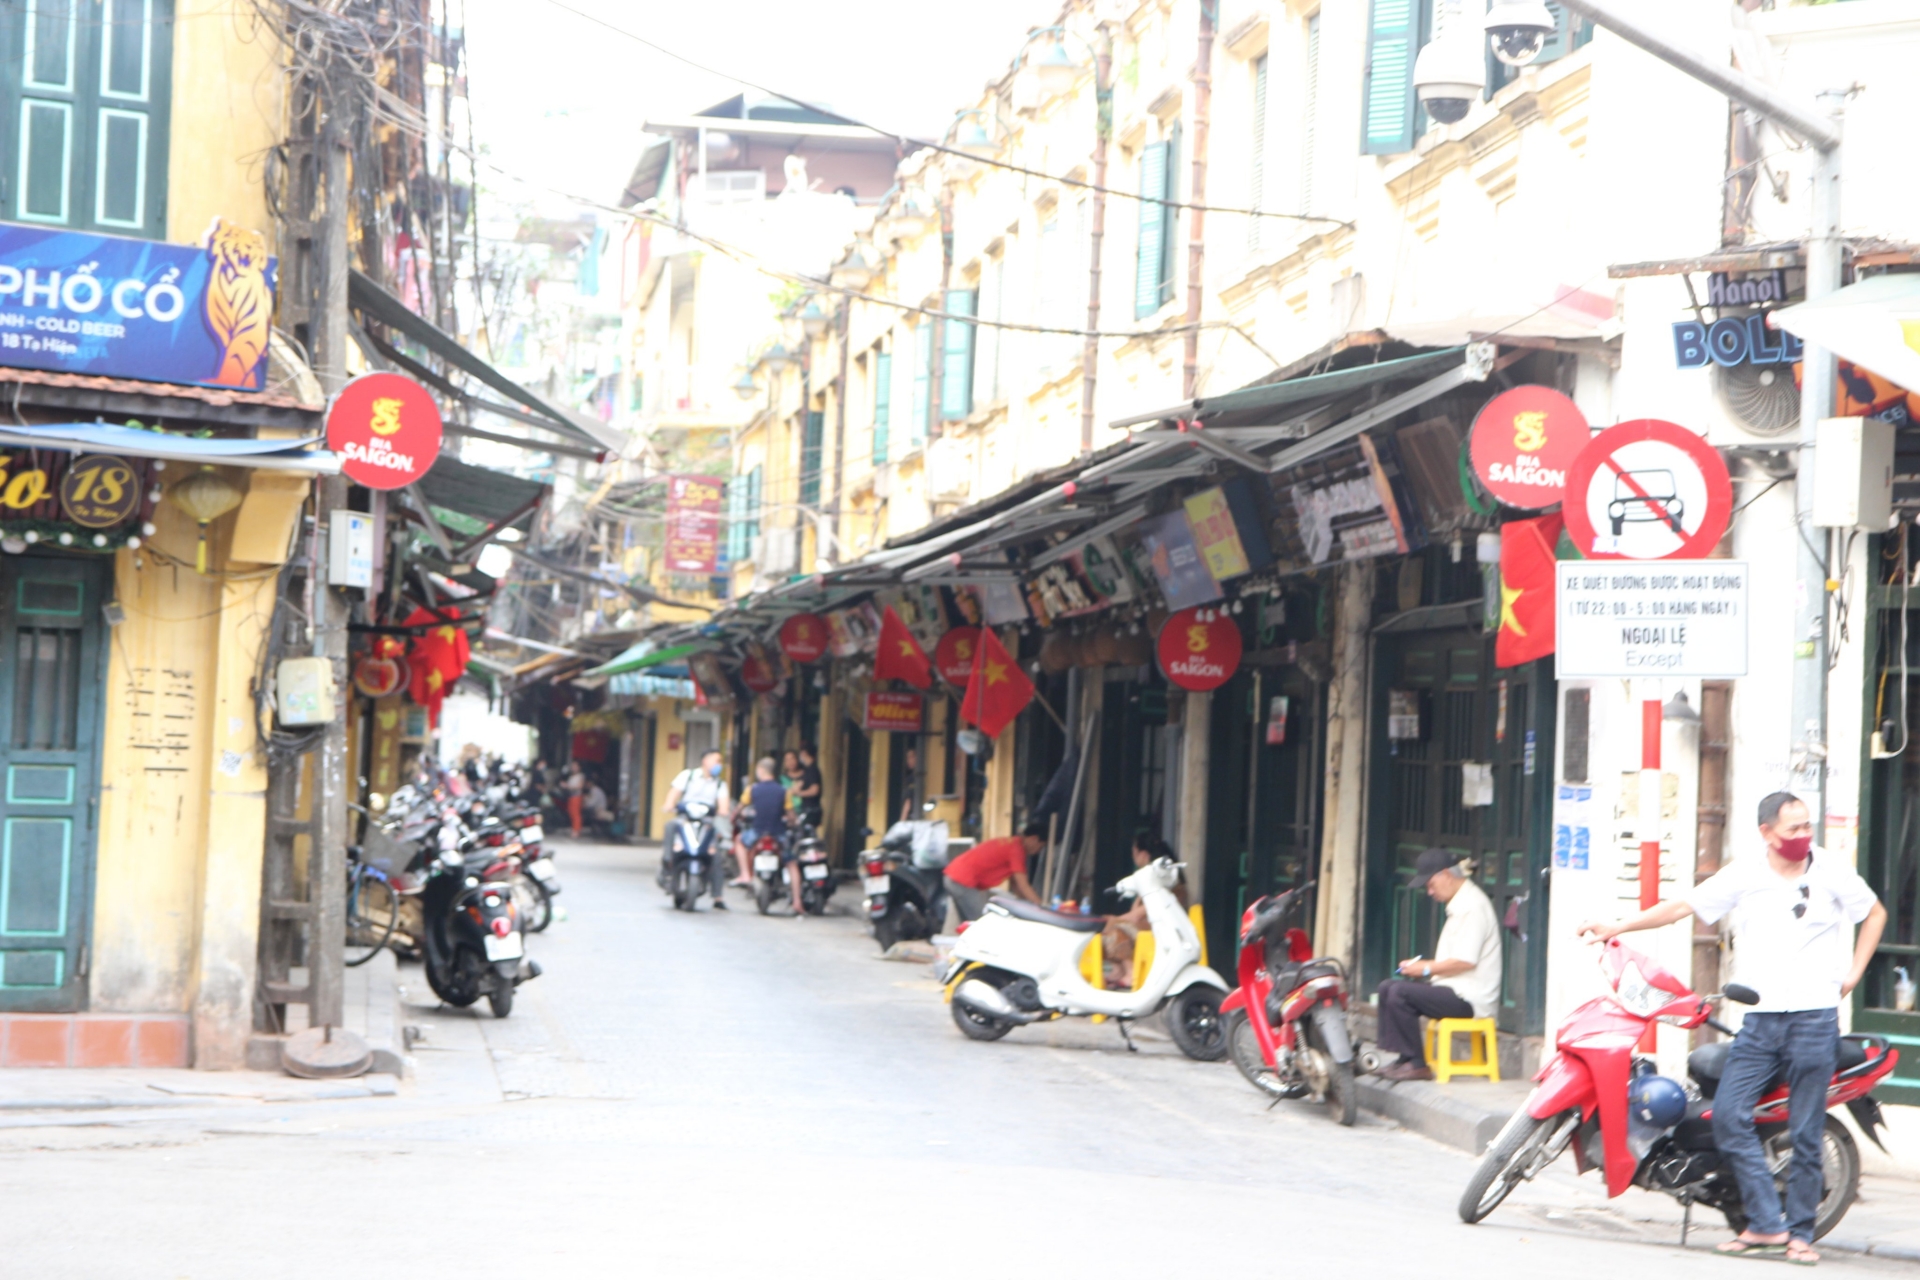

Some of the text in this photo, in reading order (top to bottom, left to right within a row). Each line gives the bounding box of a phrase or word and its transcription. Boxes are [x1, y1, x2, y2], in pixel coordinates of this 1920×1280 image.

[111, 267, 185, 322] CỔ
[1708, 270, 1782, 306] Hanoi
[35, 316, 81, 334] COLD
[82, 320, 126, 339] BEER
[1, 332, 20, 349] 18
[344, 441, 413, 473] SAIGON
[71, 465, 131, 505] 18
[1489, 462, 1566, 488] SAIGON
[1566, 576, 1579, 590] XE
[1621, 627, 1666, 648] NGOẠI
[1625, 650, 1684, 670] Except
